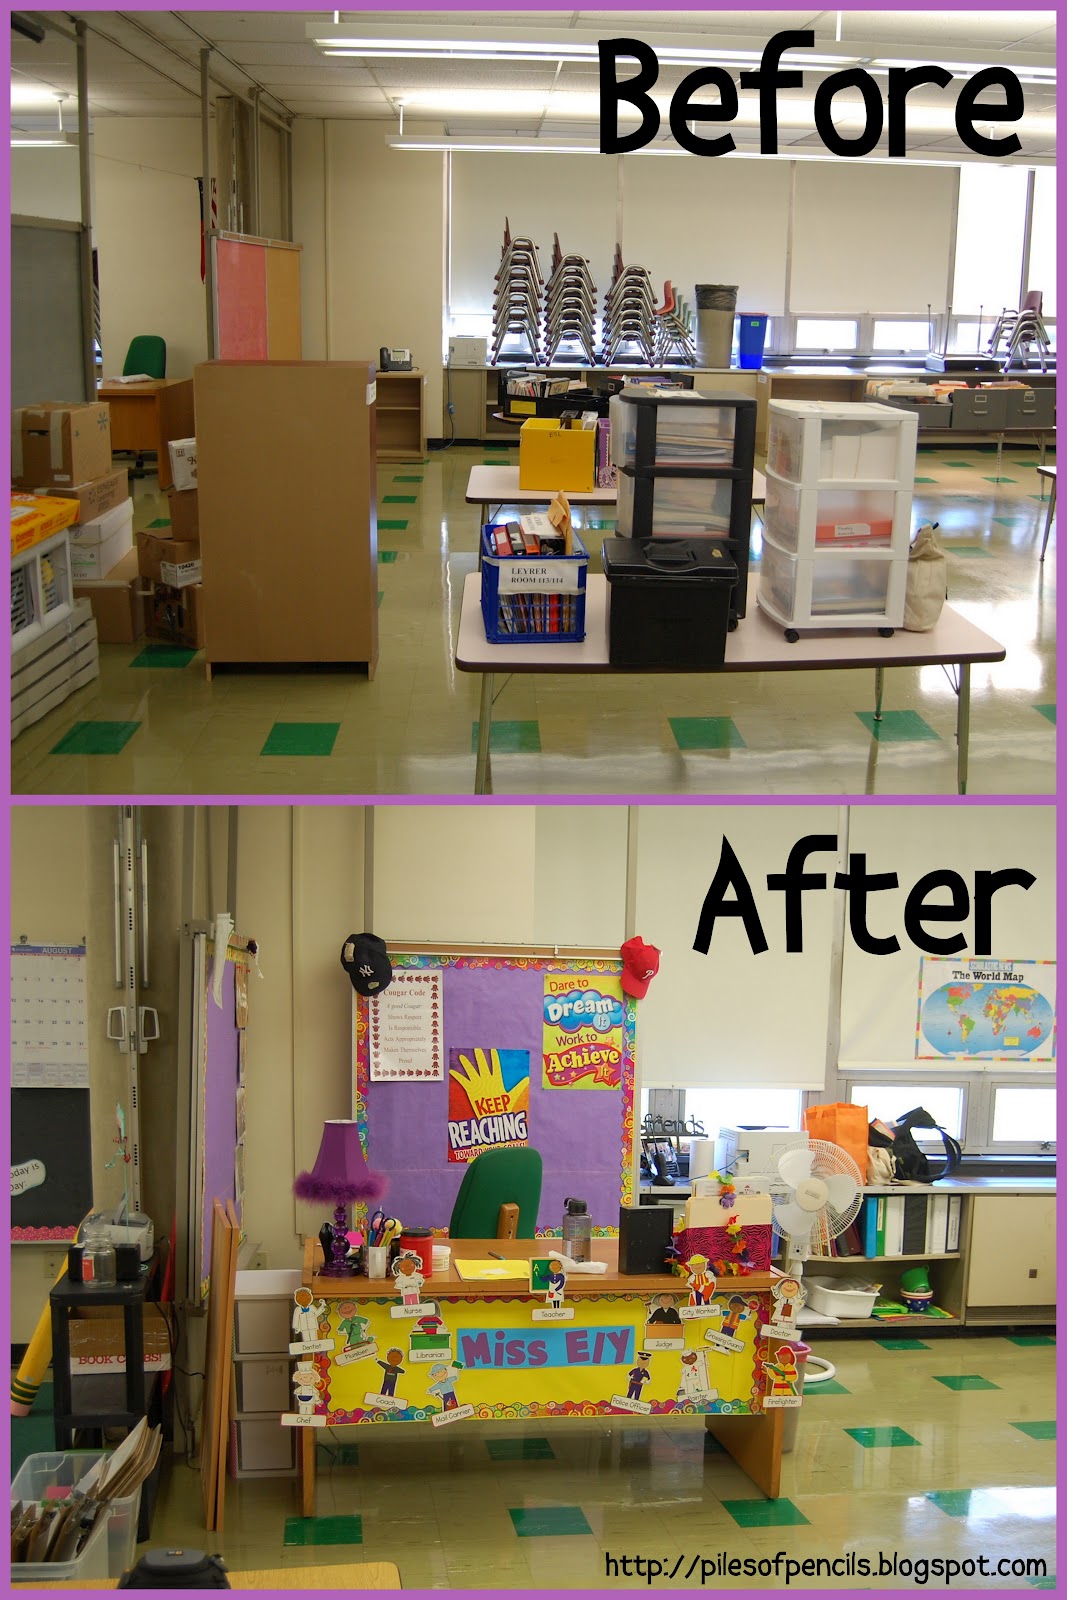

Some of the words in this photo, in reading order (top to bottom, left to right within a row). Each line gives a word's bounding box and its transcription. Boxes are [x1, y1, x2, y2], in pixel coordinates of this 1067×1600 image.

[511, 567, 547, 575] LEYRER
[952, 970, 970, 980] The
[972, 971, 1000, 980] World
[1002, 972, 1024, 982] Map
[550, 980, 575, 992] Dare
[577, 978, 589, 988] to
[547, 998, 614, 1023] Dream
[598, 1015, 607, 1027] It
[555, 1033, 584, 1047] Work
[586, 1033, 598, 1042] to
[547, 1048, 620, 1074] Achieve
[600, 1067, 609, 1077] It
[474, 1094, 511, 1116] KEEP
[448, 1111, 528, 1149] REACHING
[643, 1114, 705, 1135] friends
[10, 1166, 29, 1178] oday
[770, 1328, 791, 1337] Doctor
[416, 1351, 445, 1359] Librarian
[461, 1330, 548, 1368] Miss
[79, 1355, 113, 1364] BOOK
[116, 1353, 162, 1364] CBS!
[375, 1397, 396, 1406] Coach
[613, 1397, 629, 1407] Police
[629, 1401, 650, 1412] Officer
[767, 1398, 797, 1406] Firefighter
[448, 1408, 471, 1420] Carrier
